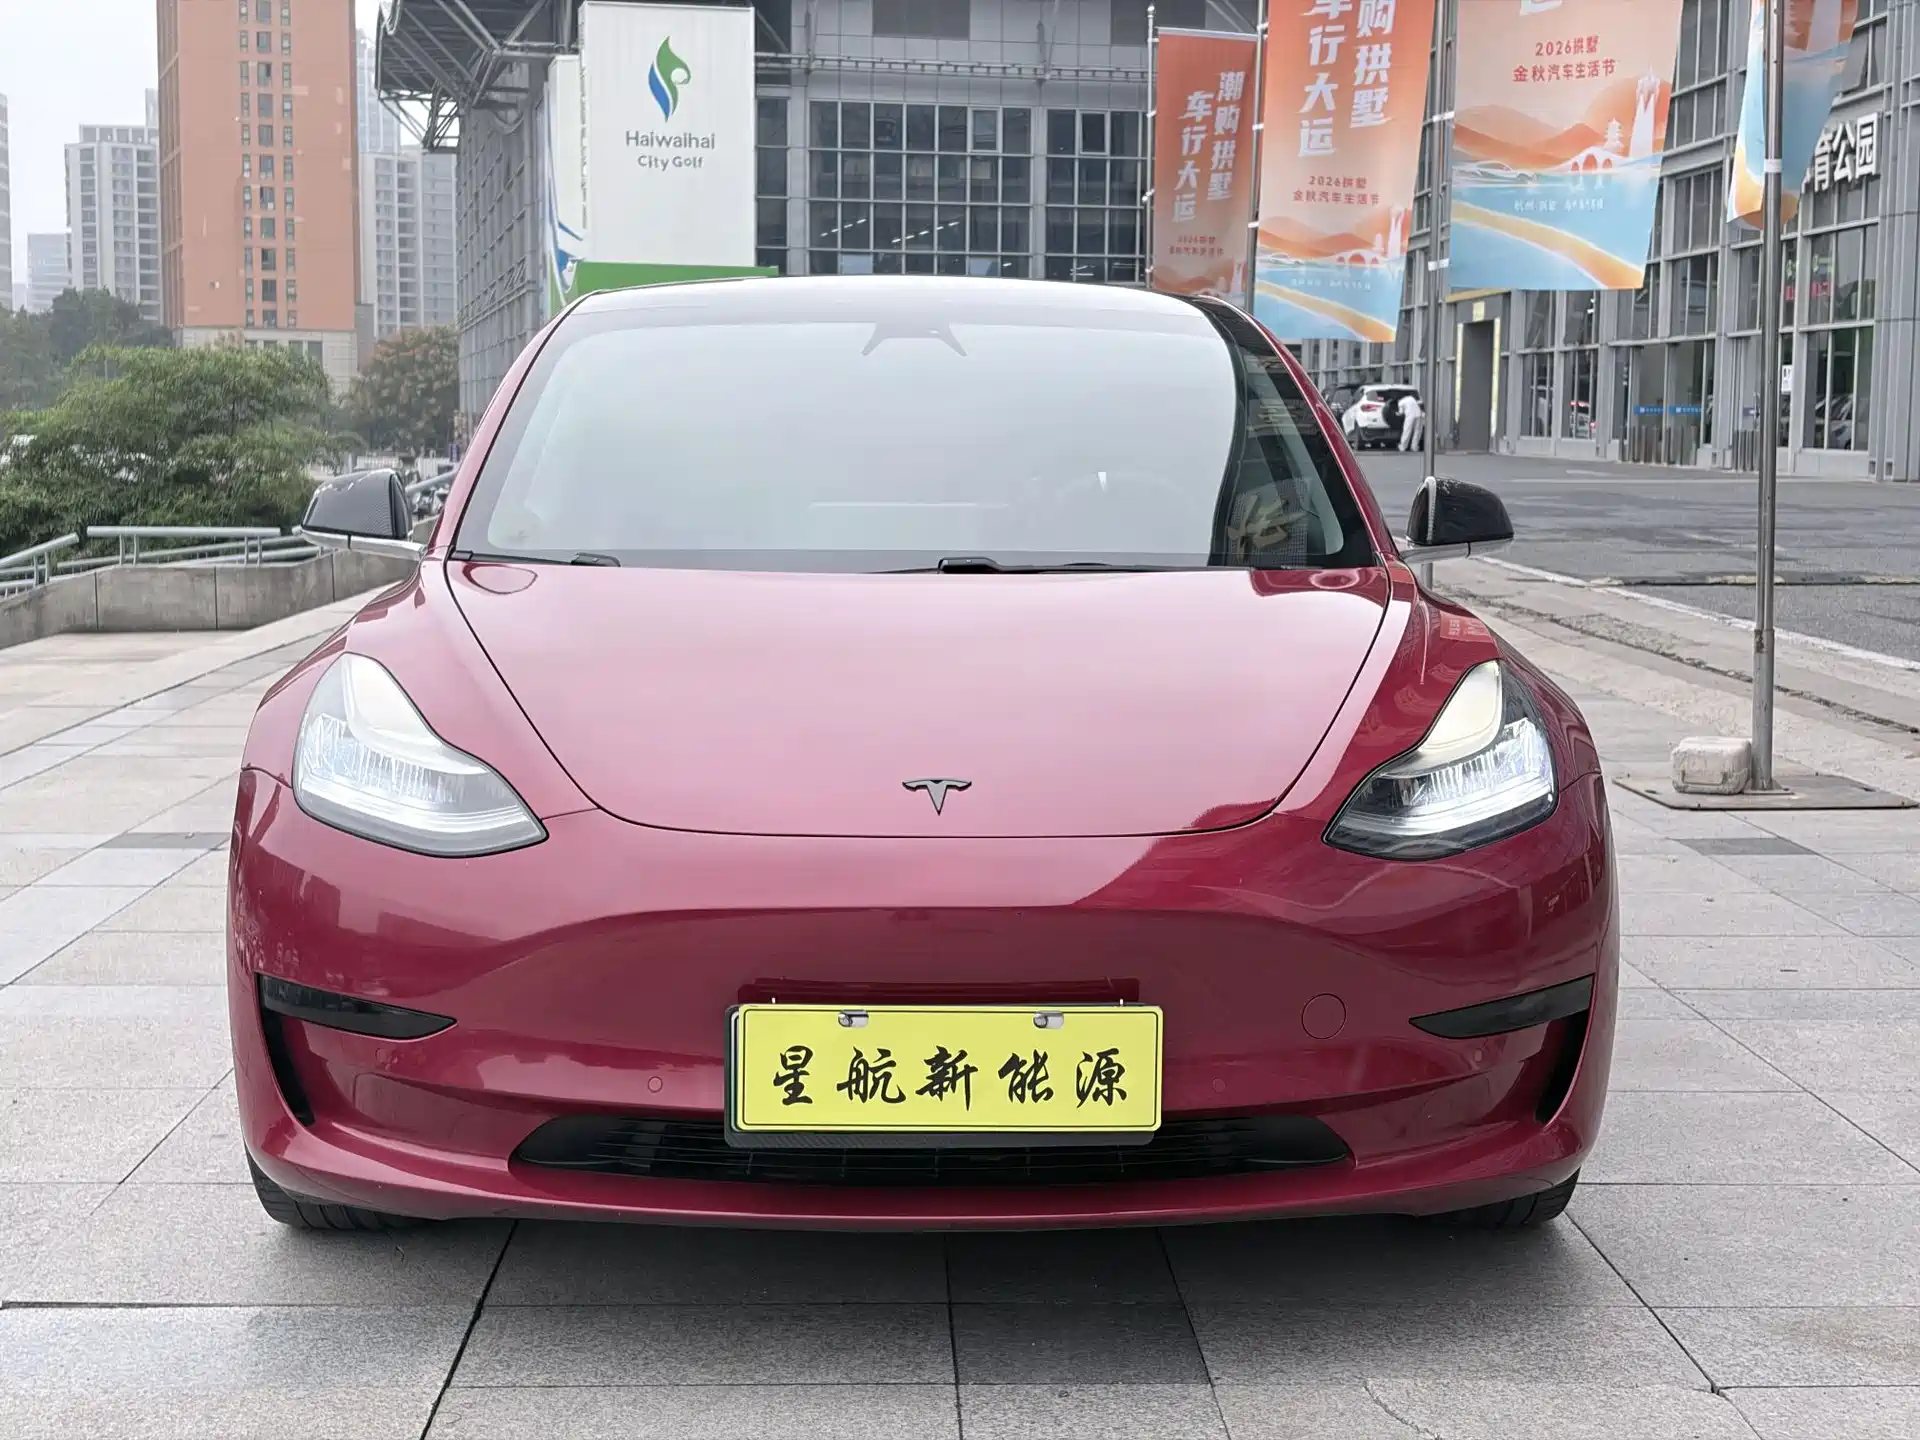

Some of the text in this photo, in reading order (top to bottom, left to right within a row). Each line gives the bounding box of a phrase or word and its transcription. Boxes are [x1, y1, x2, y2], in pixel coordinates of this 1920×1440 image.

[1350, 0, 1398, 128] 购拱墅
[1512, 58, 1616, 83] 金秋汽车生活节
[1535, 35, 1600, 57] 2026拱墅
[625, 130, 715, 149] Haiwaihai
[637, 154, 704, 172] City Golf
[1172, 90, 1214, 223] 车行大运
[1207, 71, 1246, 201] 潮购拱墅
[1802, 112, 1877, 194] 育公园
[773, 1044, 1127, 1110] 星航新能源
